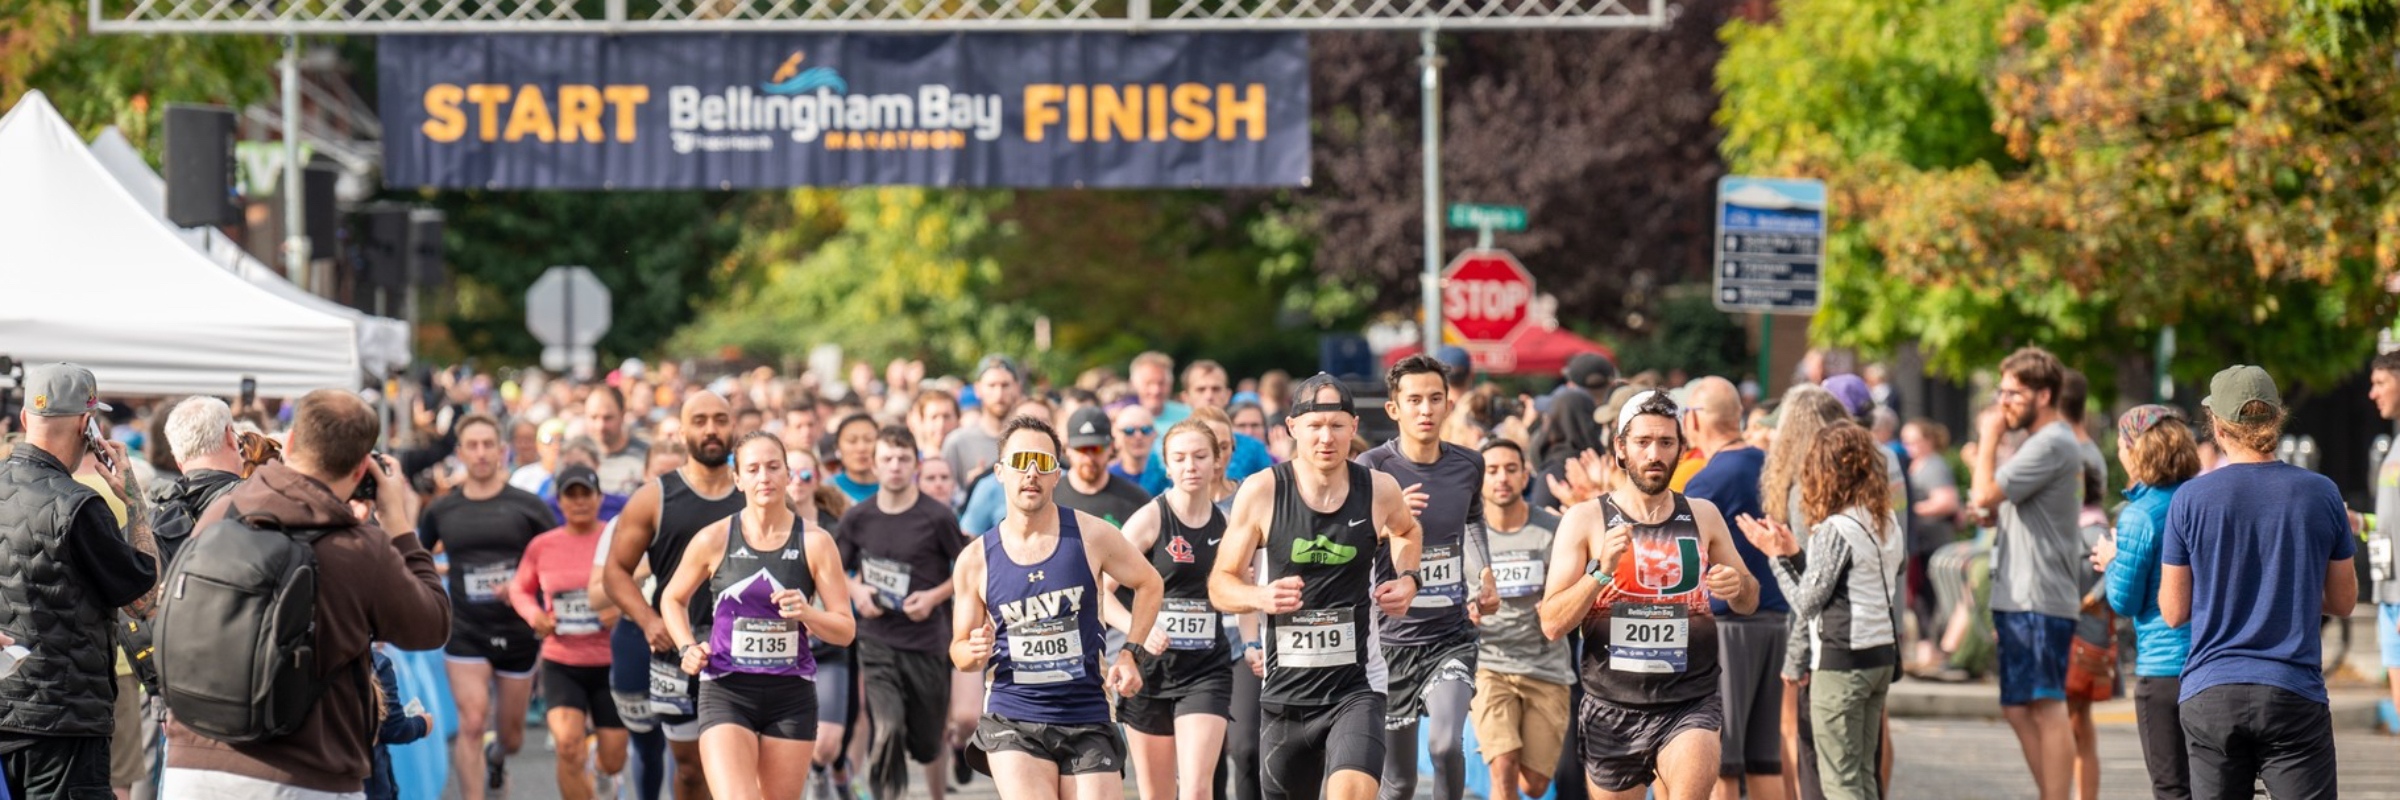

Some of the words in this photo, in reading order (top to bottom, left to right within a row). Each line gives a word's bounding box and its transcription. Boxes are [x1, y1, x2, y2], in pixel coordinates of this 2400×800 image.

[422, 83, 649, 143] START
[668, 84, 913, 143] Bellingham
[918, 84, 1002, 141] Bay
[1023, 83, 1268, 143] FINISH
[824, 130, 966, 151] MARATHON
[1443, 279, 1527, 321] STOP
[1423, 563, 1451, 582] 141
[1492, 566, 1531, 582] 2267
[998, 586, 1085, 625] NAVY
[1166, 617, 1207, 633] 2157
[1625, 624, 1675, 643] 2012
[744, 637, 787, 653] 2135
[1021, 638, 1068, 657] 2408
[1292, 630, 1341, 649] 2119
